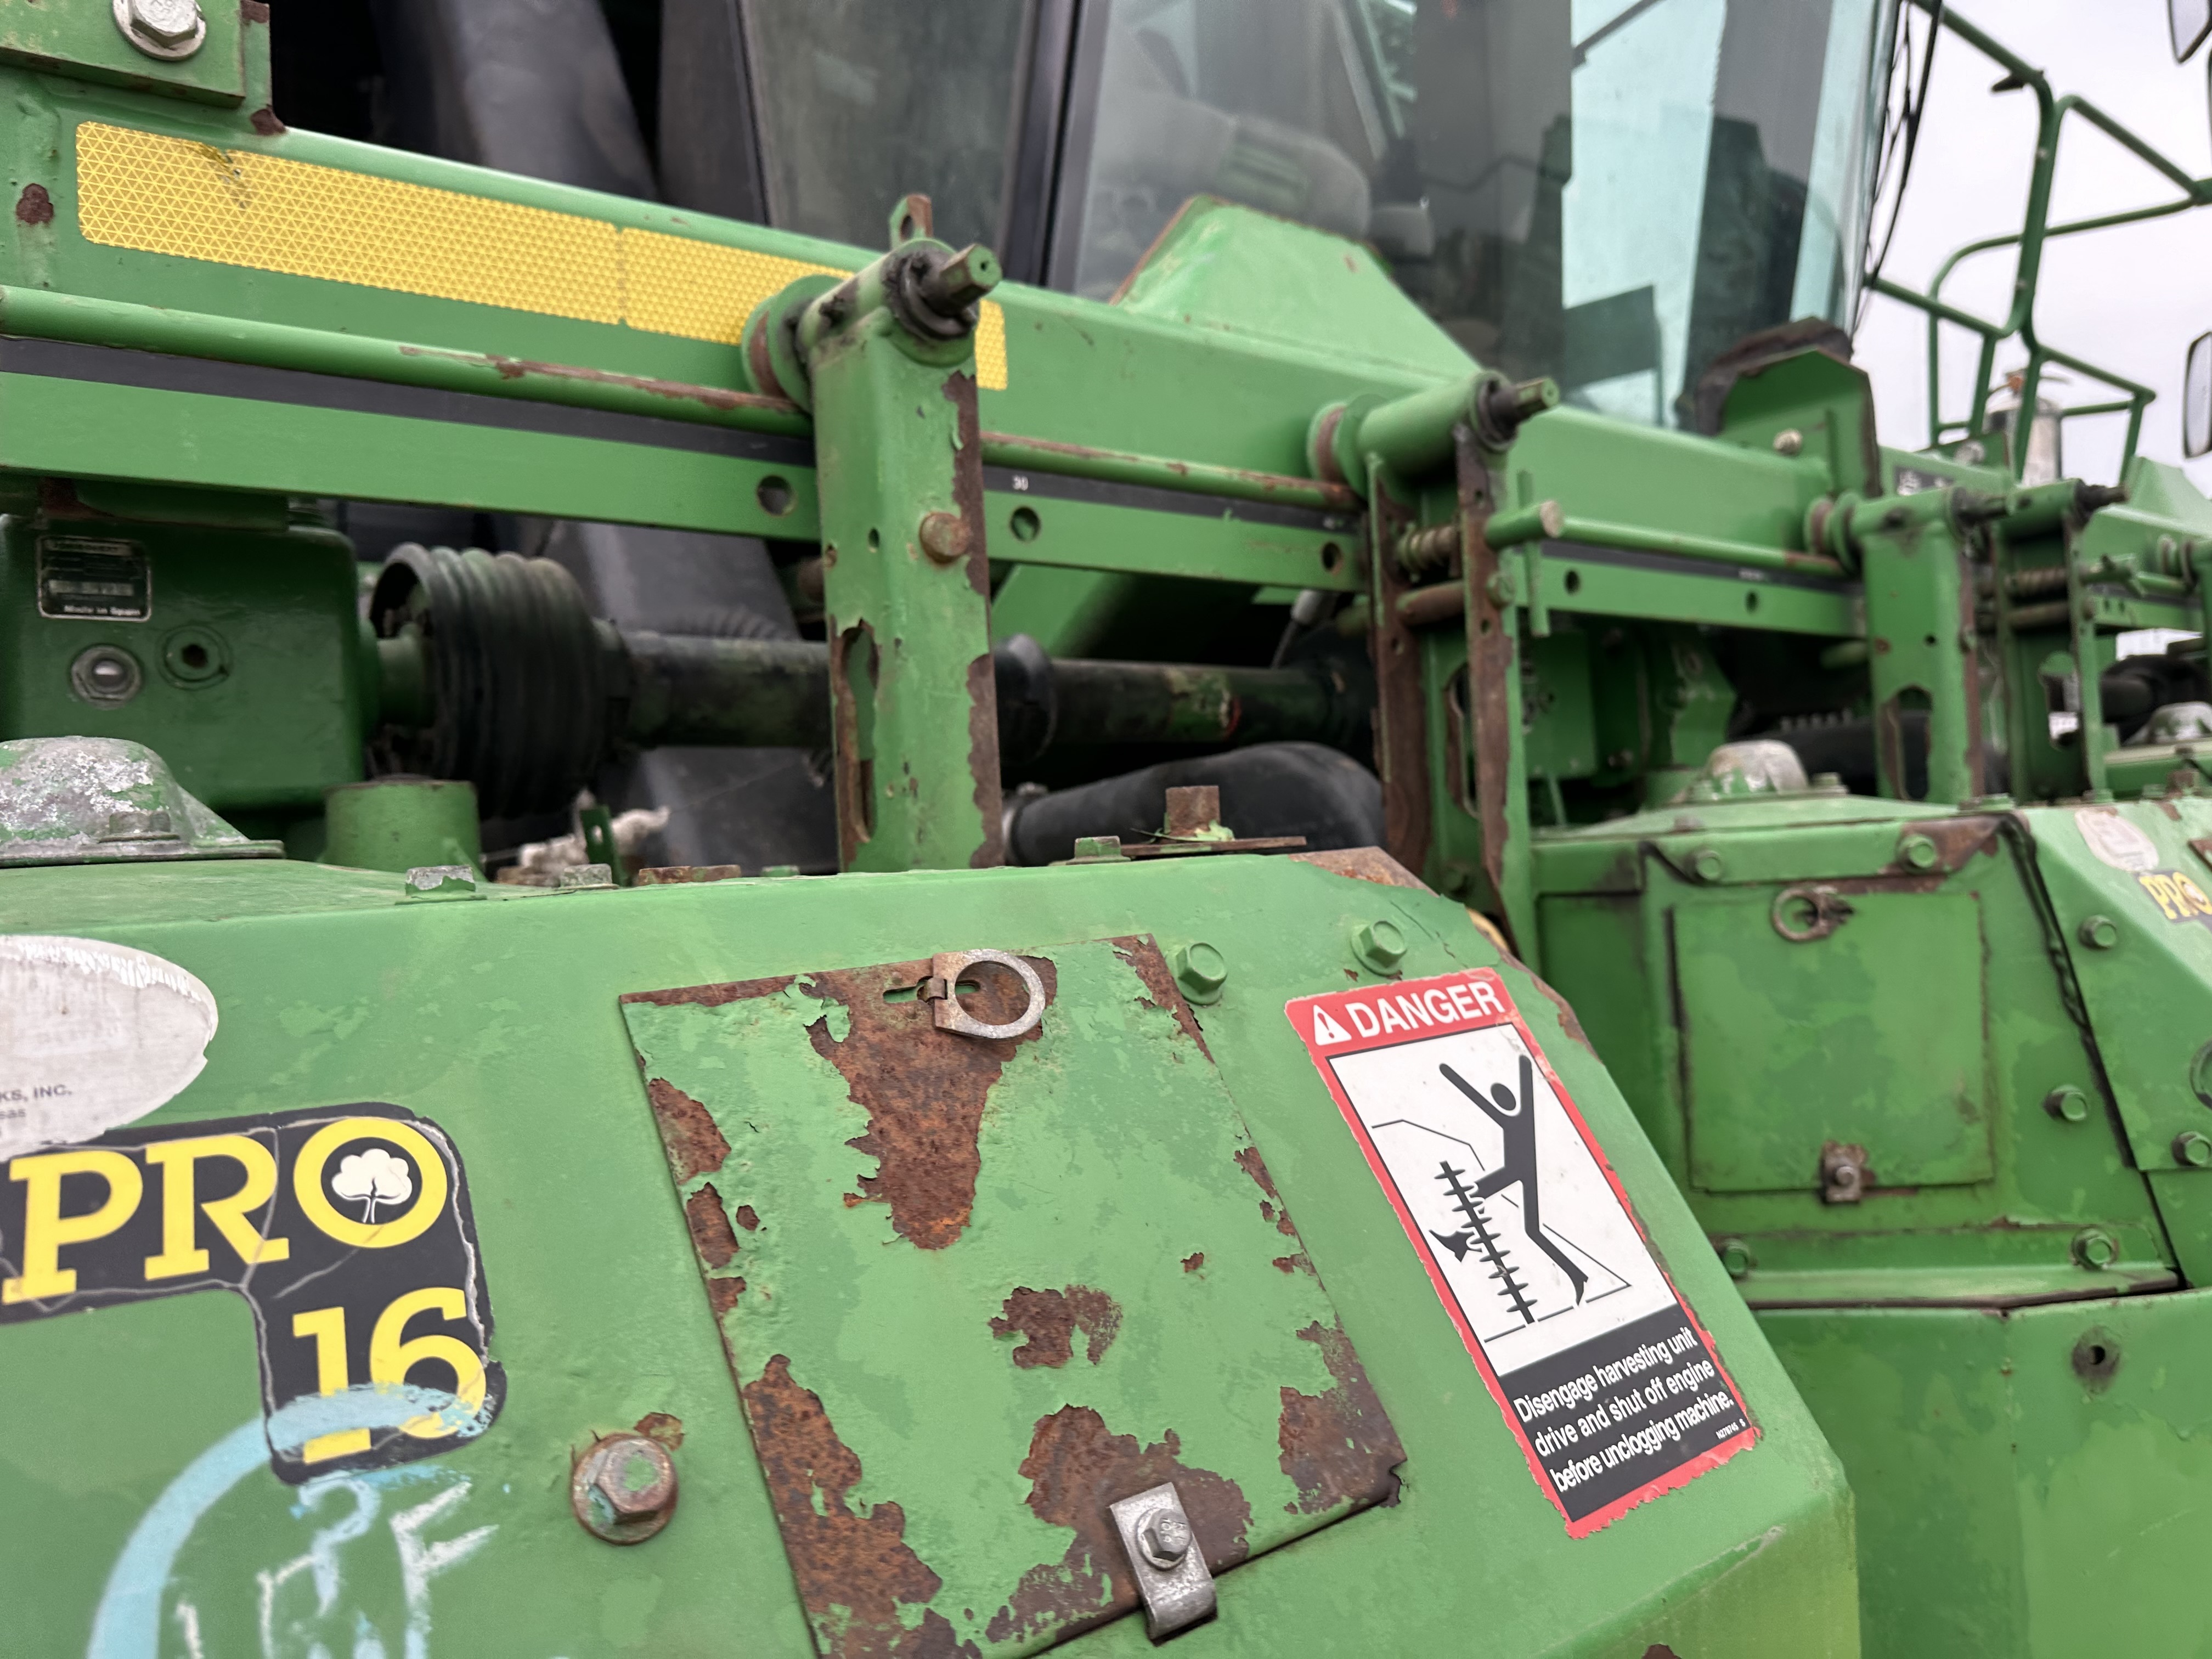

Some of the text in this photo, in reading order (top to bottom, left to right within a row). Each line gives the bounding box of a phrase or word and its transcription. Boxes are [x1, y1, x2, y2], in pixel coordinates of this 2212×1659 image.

[2138, 871, 2212, 919] PRO
[1345, 981, 1505, 1038] DANGER
[34, 1084, 72, 1099] INC.
[3, 1117, 448, 1305] PRO
[292, 1287, 487, 1464] 16
[1513, 1327, 1698, 1423] Disengage harvesting unit
[1535, 1359, 1715, 1457] drive and shut off engine
[1550, 1391, 1735, 1493] before unclogging machine.
